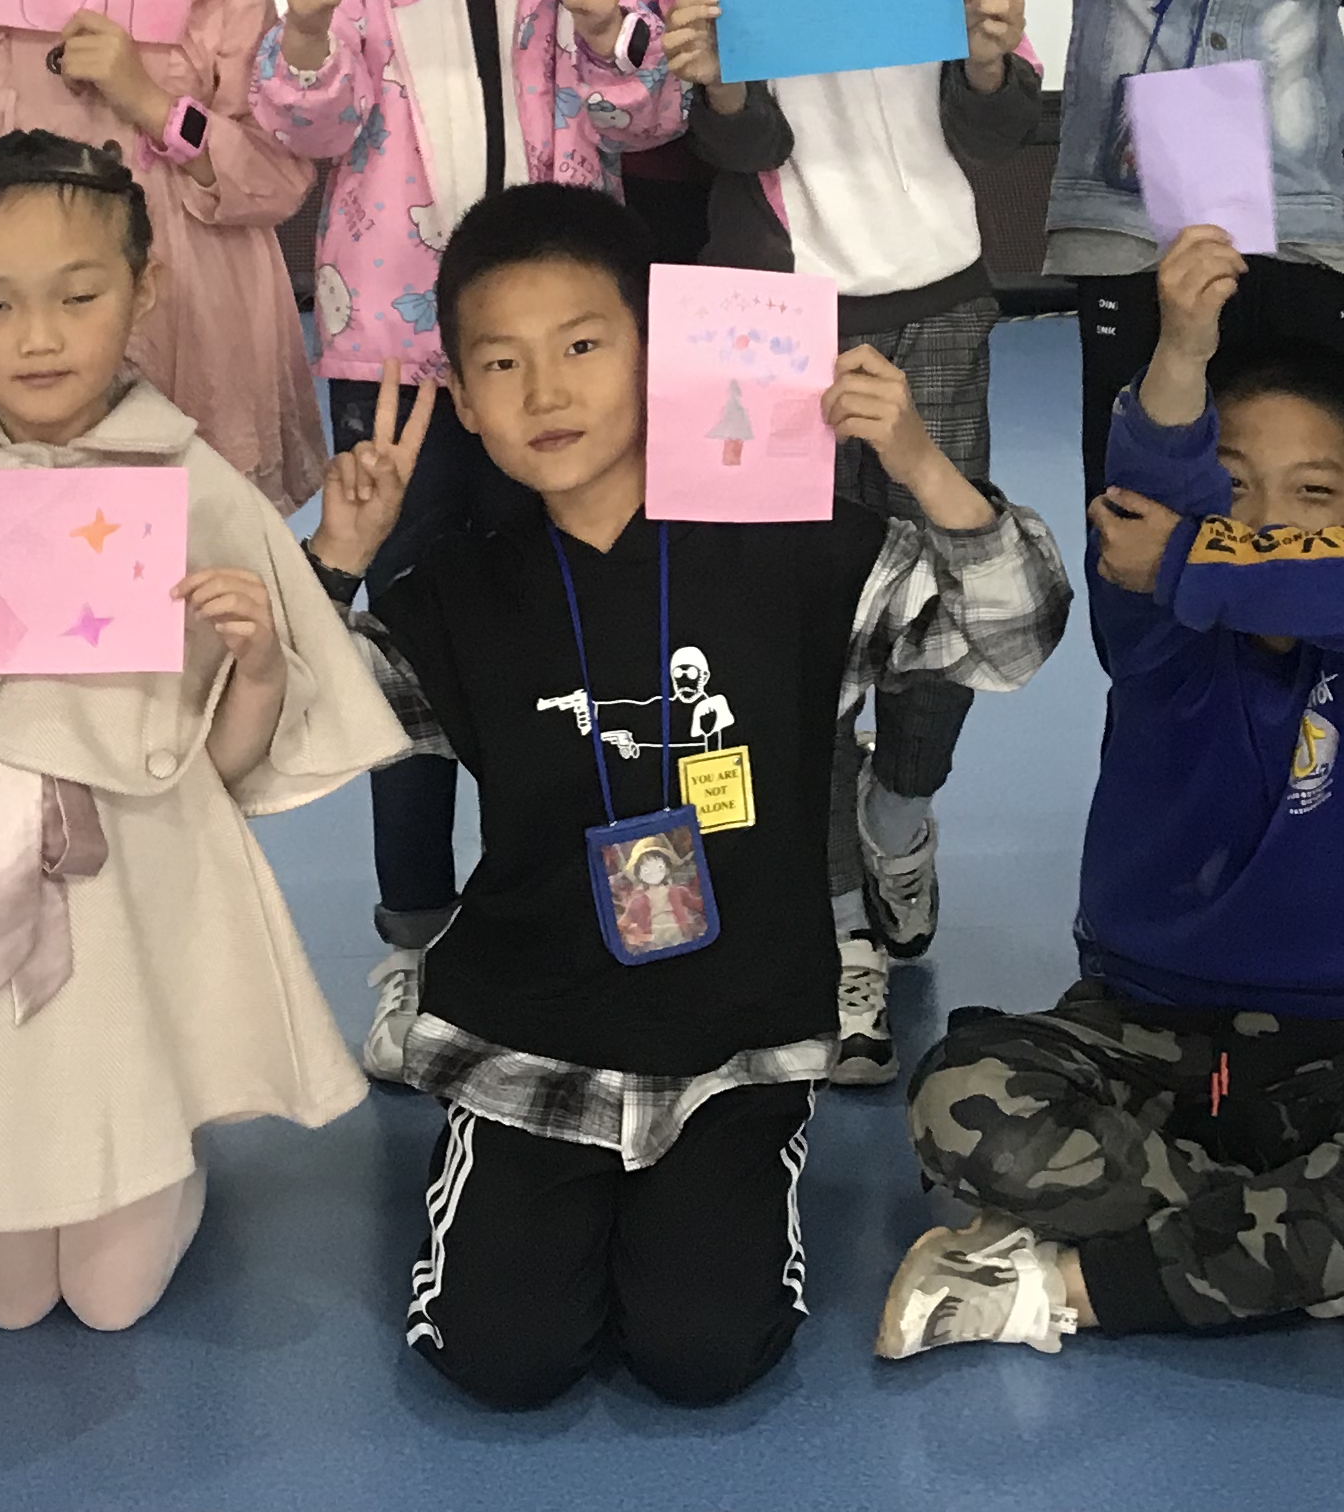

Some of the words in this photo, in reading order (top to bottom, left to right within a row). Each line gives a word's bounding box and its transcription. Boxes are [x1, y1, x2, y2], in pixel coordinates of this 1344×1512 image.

[691, 772, 716, 786] YOU
[717, 768, 740, 781] ARE
[704, 784, 729, 798] NOT
[699, 799, 737, 815] ALONE
